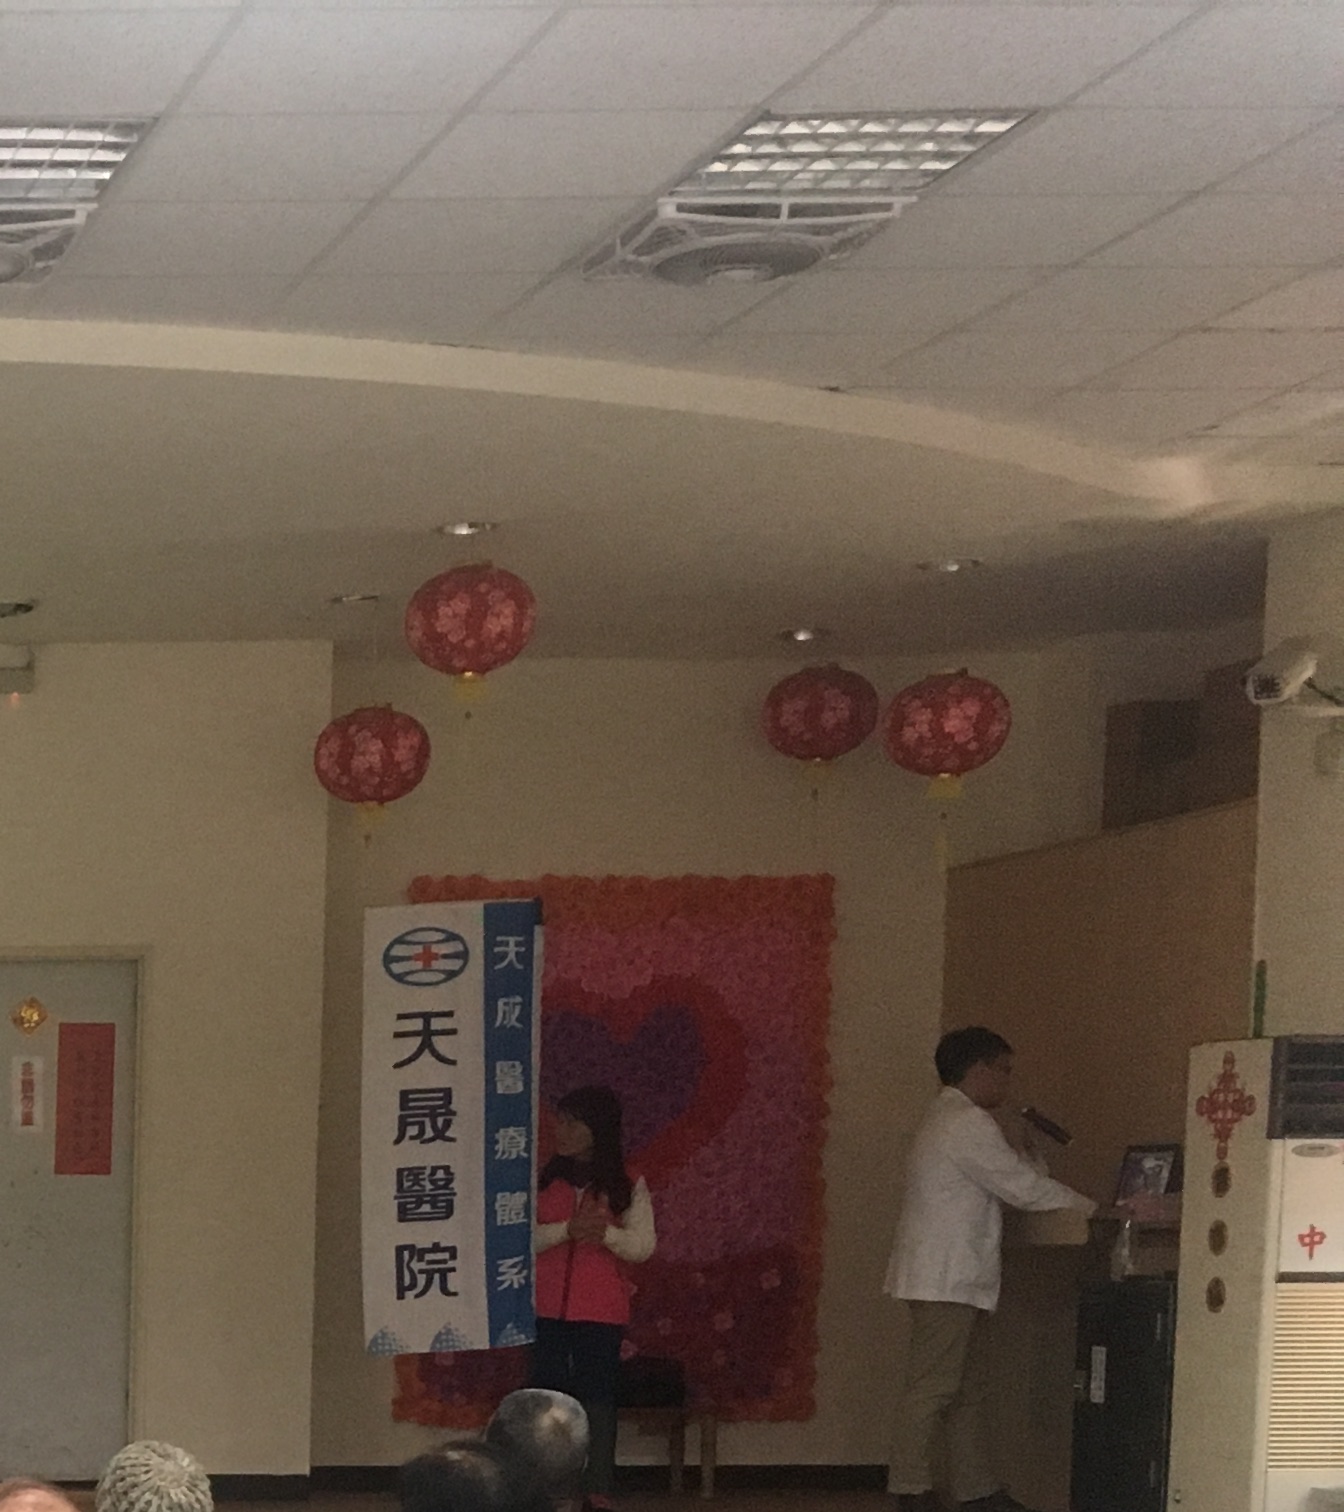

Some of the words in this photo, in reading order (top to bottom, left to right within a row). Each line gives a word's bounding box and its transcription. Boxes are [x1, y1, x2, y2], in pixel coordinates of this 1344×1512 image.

[391, 1009, 459, 1301] 天晟醫院
[493, 934, 529, 1292] 天成醫療體系
[1297, 1222, 1328, 1261] 中
